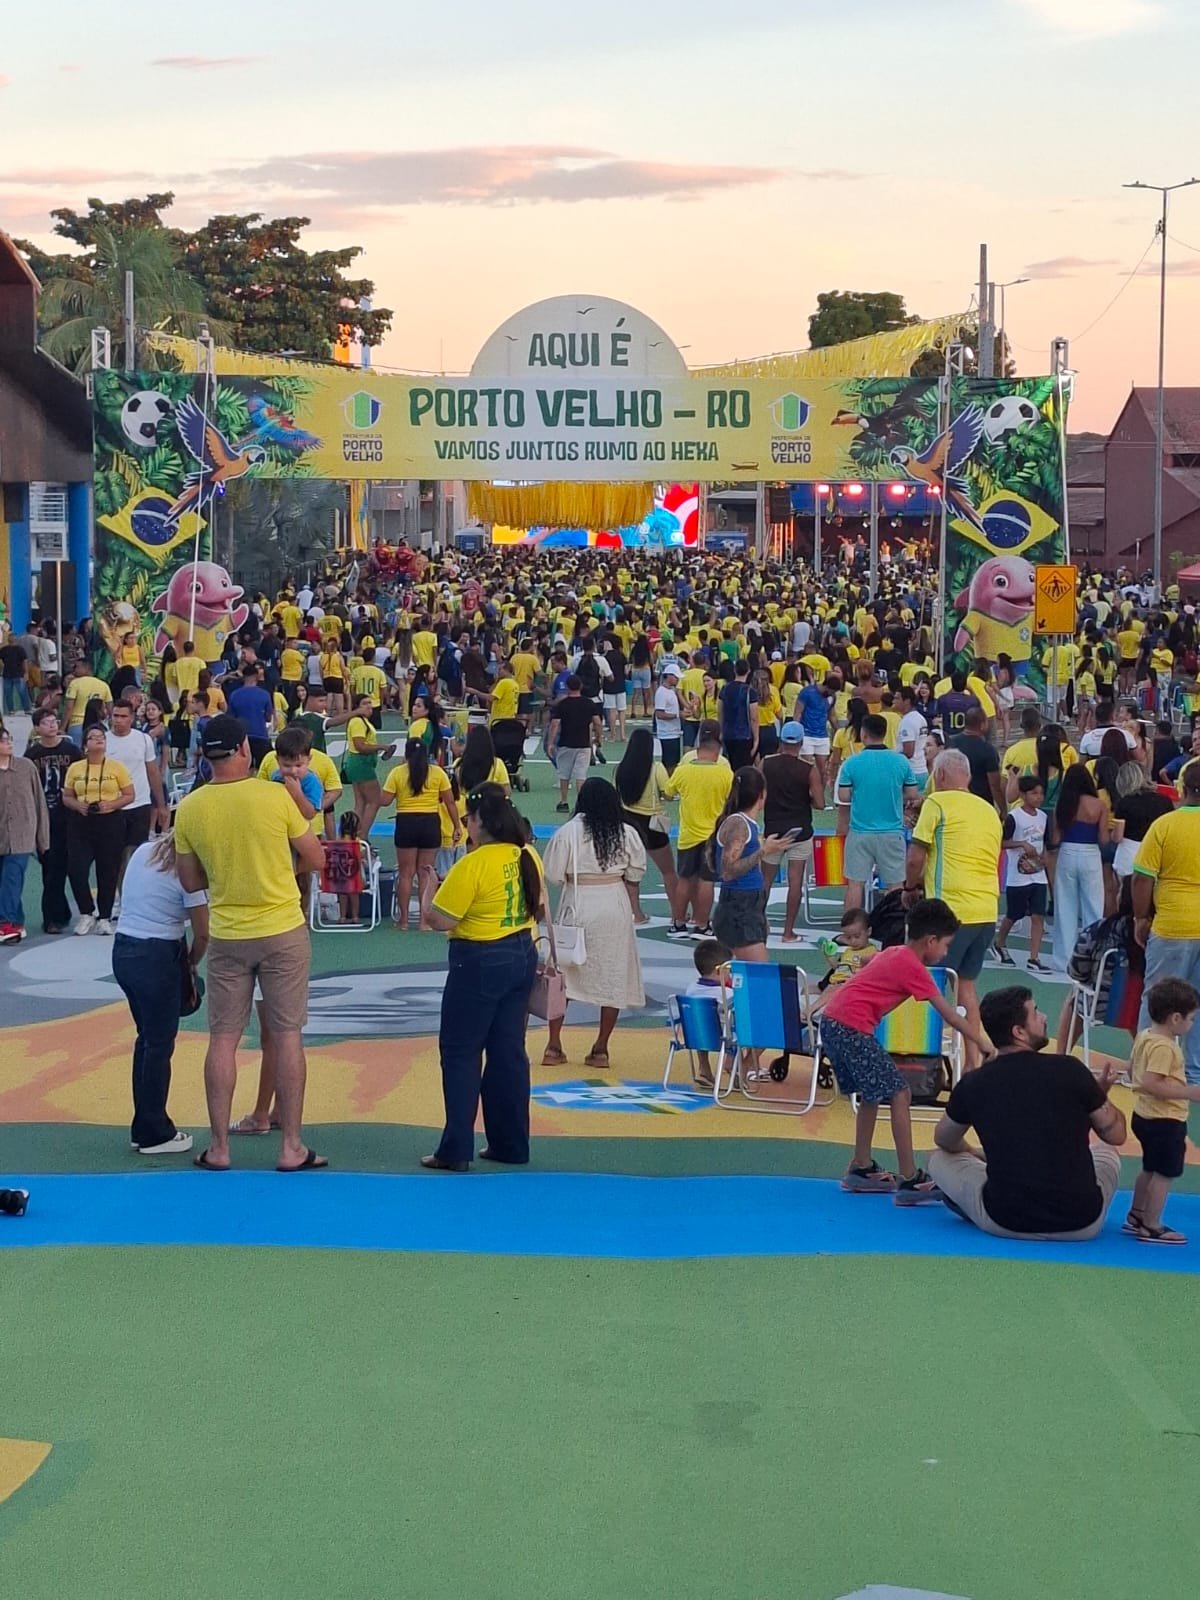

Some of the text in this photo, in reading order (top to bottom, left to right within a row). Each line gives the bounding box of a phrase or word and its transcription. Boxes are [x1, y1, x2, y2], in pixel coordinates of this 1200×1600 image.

[528, 317, 632, 369] AQUI É
[409, 388, 526, 428] PORTO
[536, 389, 663, 428] VELHO
[707, 390, 751, 428] RO
[342, 440, 383, 450] PORTO
[434, 440, 719, 461] VAMOS JUNTOS RUMO AO HEXA
[771, 442, 811, 453] PORTO
[343, 451, 383, 462] VELHO
[771, 453, 811, 464] VELHO
[362, 677, 375, 695] 10
[949, 711, 966, 729] 10
